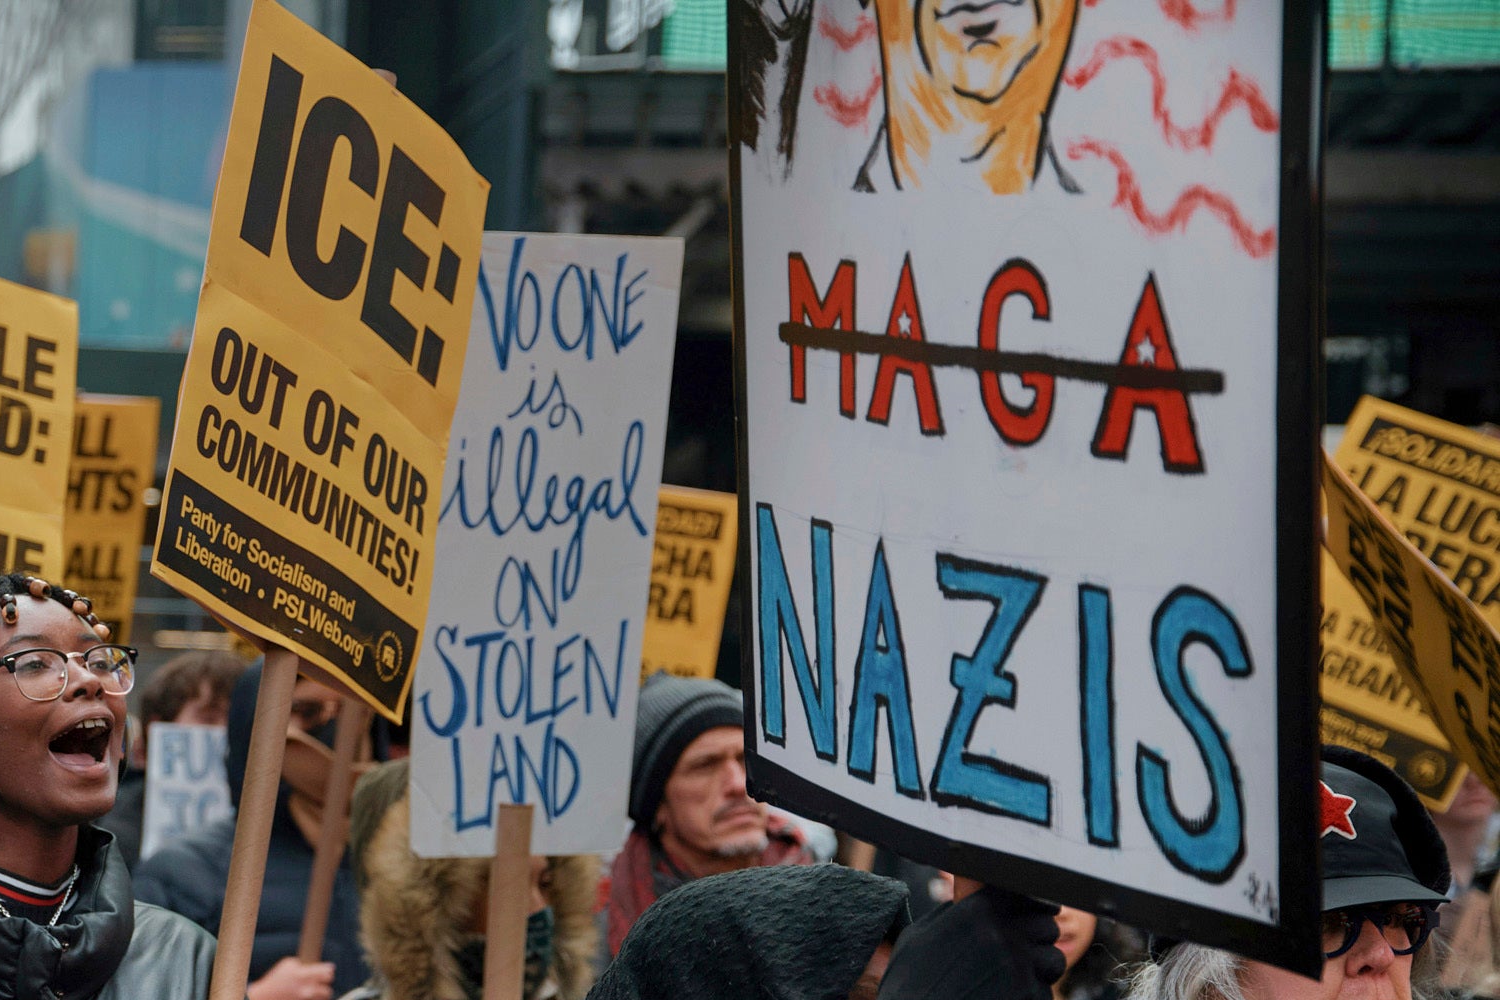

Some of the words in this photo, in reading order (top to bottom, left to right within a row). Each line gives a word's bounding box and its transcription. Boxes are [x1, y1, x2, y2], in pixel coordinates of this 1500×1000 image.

[239, 52, 462, 389] ICE:
[551, 253, 649, 361] ONE
[787, 250, 1209, 475] MAGA
[211, 326, 299, 430] OUT
[303, 388, 361, 469] OF
[363, 433, 429, 538] OUR
[507, 365, 583, 437] is
[180, 494, 220, 544] Party
[222, 523, 247, 556] for
[247, 538, 329, 602] Socialism
[328, 589, 356, 622] and
[196, 403, 419, 597] COMMUNITIES!
[437, 420, 649, 602] illegal
[174, 526, 252, 594] Liberation
[272, 587, 365, 668] PSLWeb.org
[495, 546, 561, 631] ON
[420, 619, 629, 740] STOLEN
[755, 502, 1256, 886] NAZIS
[450, 722, 580, 832] LAND
